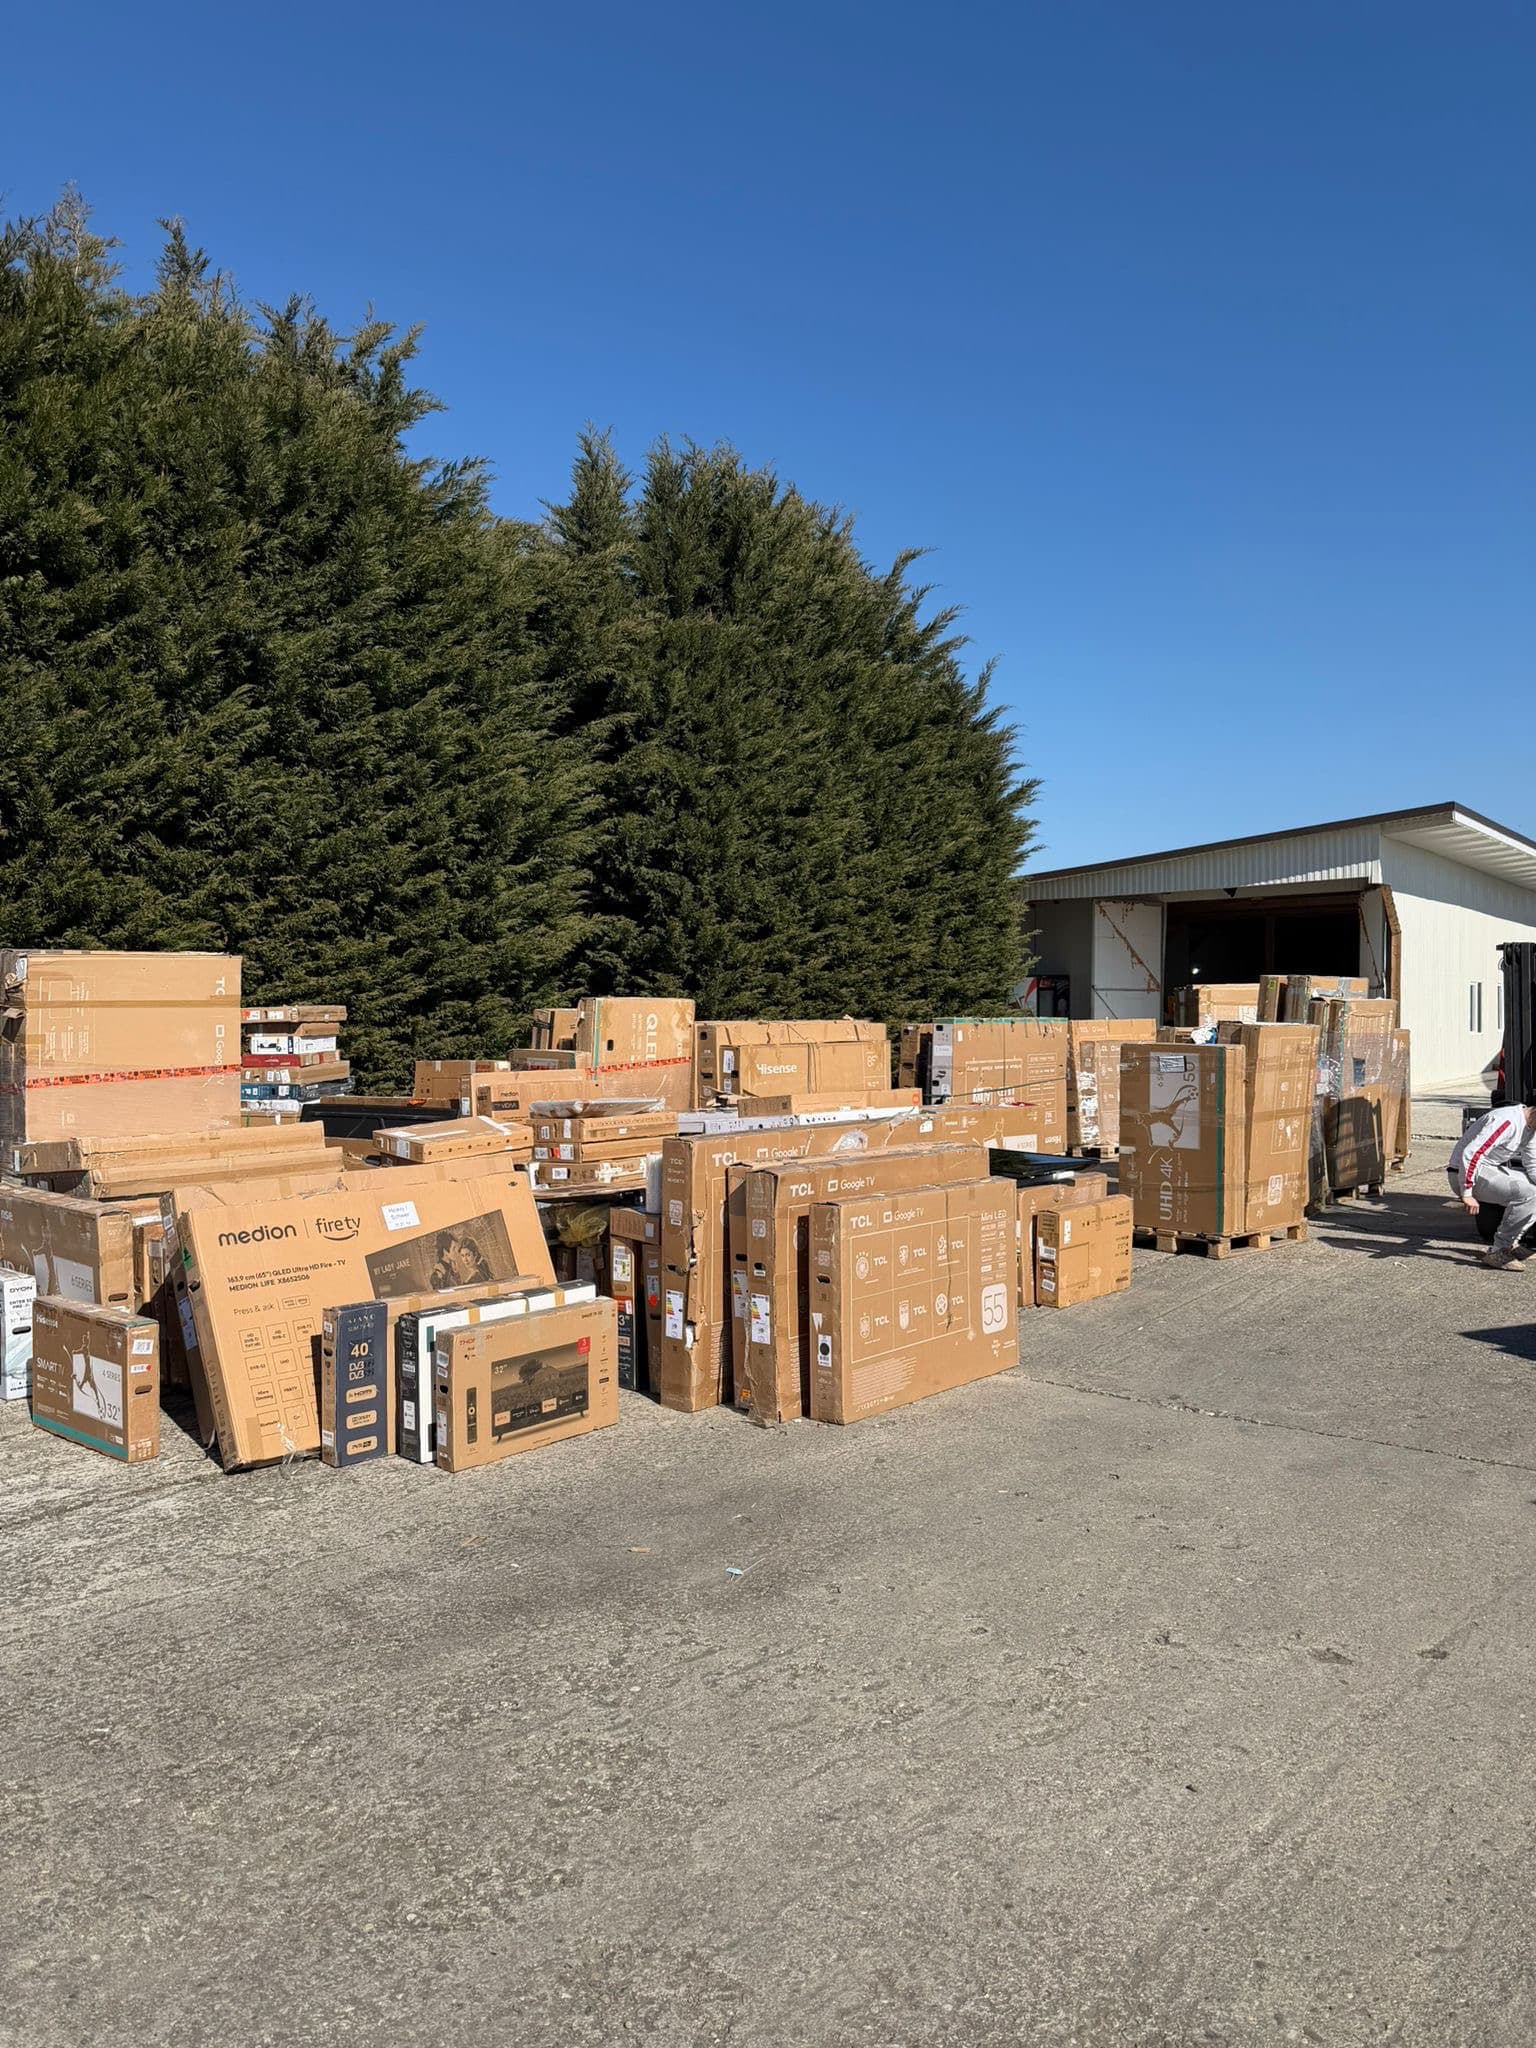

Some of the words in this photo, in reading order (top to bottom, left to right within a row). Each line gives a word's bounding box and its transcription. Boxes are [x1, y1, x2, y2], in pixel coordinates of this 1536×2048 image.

[215, 976, 225, 996] TC
[756, 1063, 798, 1075] Hisense
[790, 1183, 815, 1197] TCL
[839, 1178, 866, 1191] Google
[865, 1176, 876, 1187] TV
[1159, 1180, 1174, 1222] UHD
[850, 1215, 873, 1229] TCL
[894, 1209, 915, 1222] Google
[914, 1207, 925, 1216] TV
[218, 1225, 297, 1247] medion
[951, 1240, 965, 1249] TCL
[913, 1247, 928, 1257] TCL
[873, 1256, 888, 1265] TCL
[229, 1283, 259, 1292] MEDION
[951, 1296, 964, 1305] TCL
[913, 1305, 928, 1315] TCL
[874, 1315, 890, 1326] TCL
[36, 1357, 58, 1374] SMART
